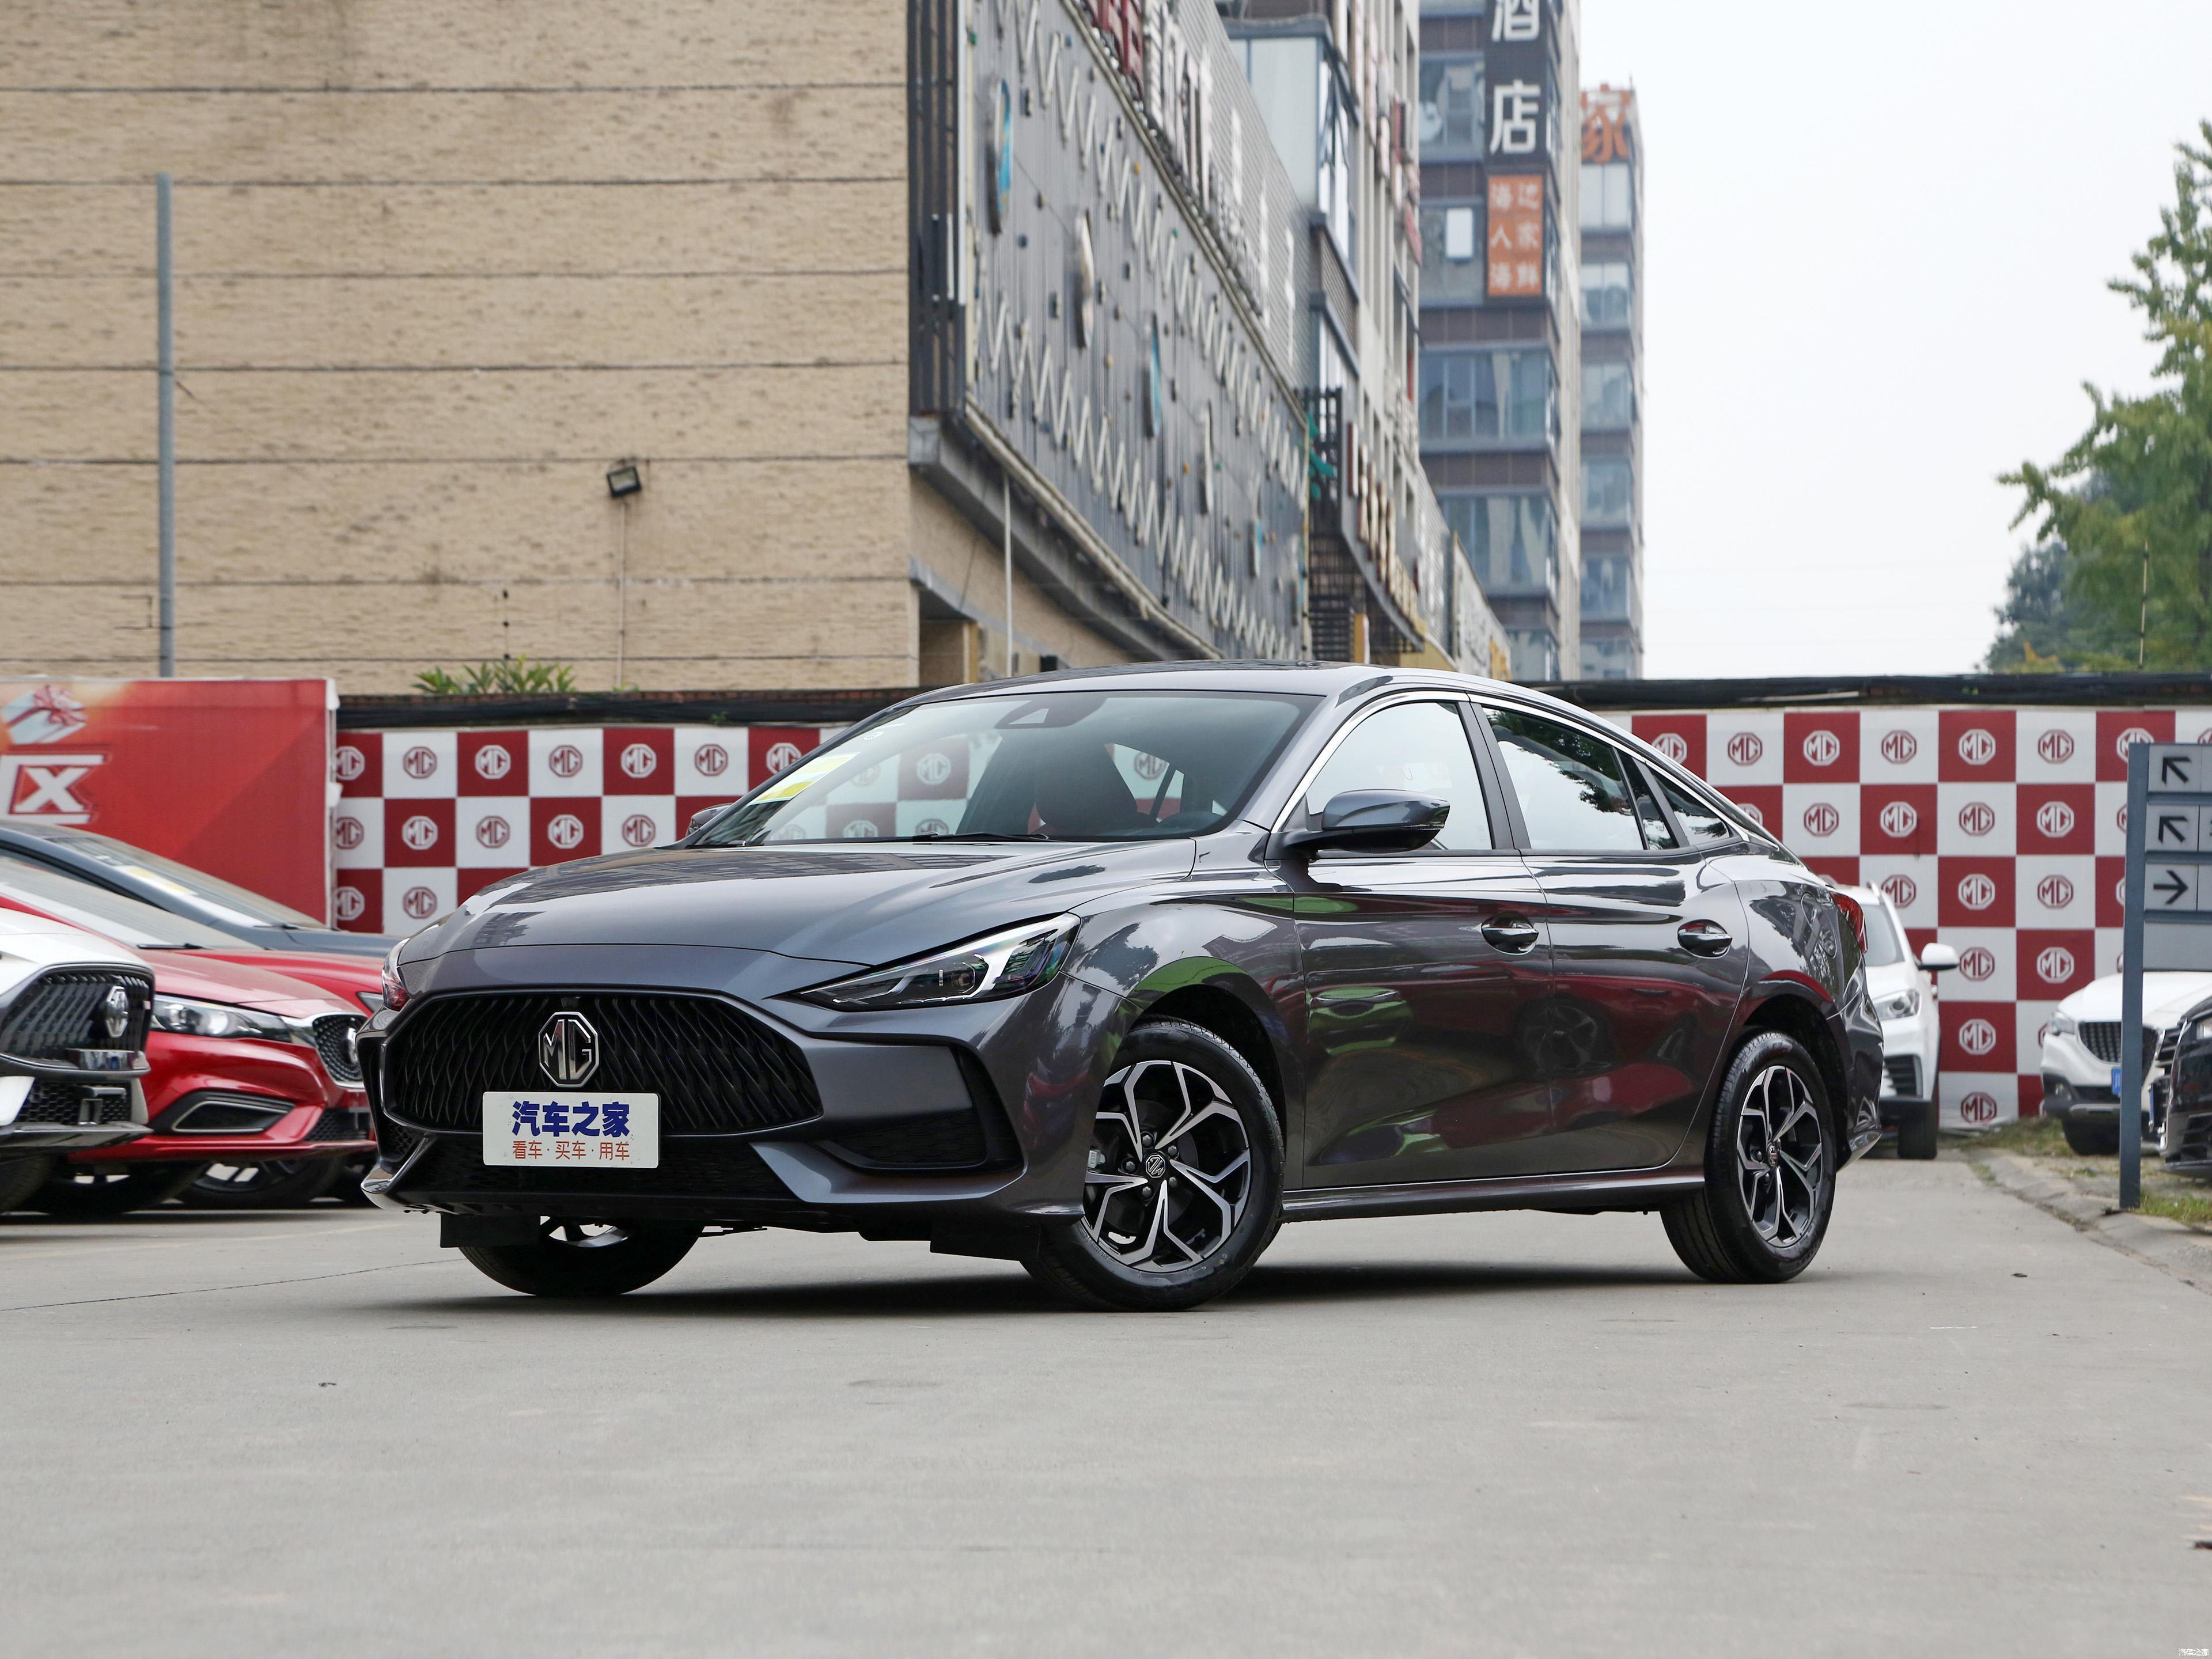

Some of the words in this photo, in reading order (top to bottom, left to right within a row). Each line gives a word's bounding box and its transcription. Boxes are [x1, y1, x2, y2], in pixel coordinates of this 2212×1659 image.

[552, 747, 580, 775] MG
[623, 746, 654, 776] MG
[698, 747, 725, 774] MG
[1730, 734, 1760, 763] MG
[1806, 733, 1838, 764] MG
[1884, 733, 1914, 762] MG
[1960, 730, 1994, 763] MG
[2040, 732, 2071, 762] MG
[406, 749, 435, 777] MG
[477, 747, 509, 777] MG
[405, 818, 435, 847] MG
[479, 818, 507, 846] MG
[550, 817, 581, 846] MG
[624, 817, 653, 844] MG
[1806, 805, 1837, 835] MG
[1883, 804, 1915, 835] MG
[1961, 805, 1993, 834] MG
[2039, 804, 2071, 835] MG
[406, 888, 435, 917] MG
[1960, 876, 1993, 908] MG
[2040, 877, 2071, 906] MG
[1962, 949, 1993, 978] MG
[2039, 949, 2072, 980] MG
[543, 1018, 593, 1080] MG
[1961, 1021, 1994, 1052] MG
[512, 1100, 630, 1138] 汽车之家
[1963, 1094, 1995, 1122] MG
